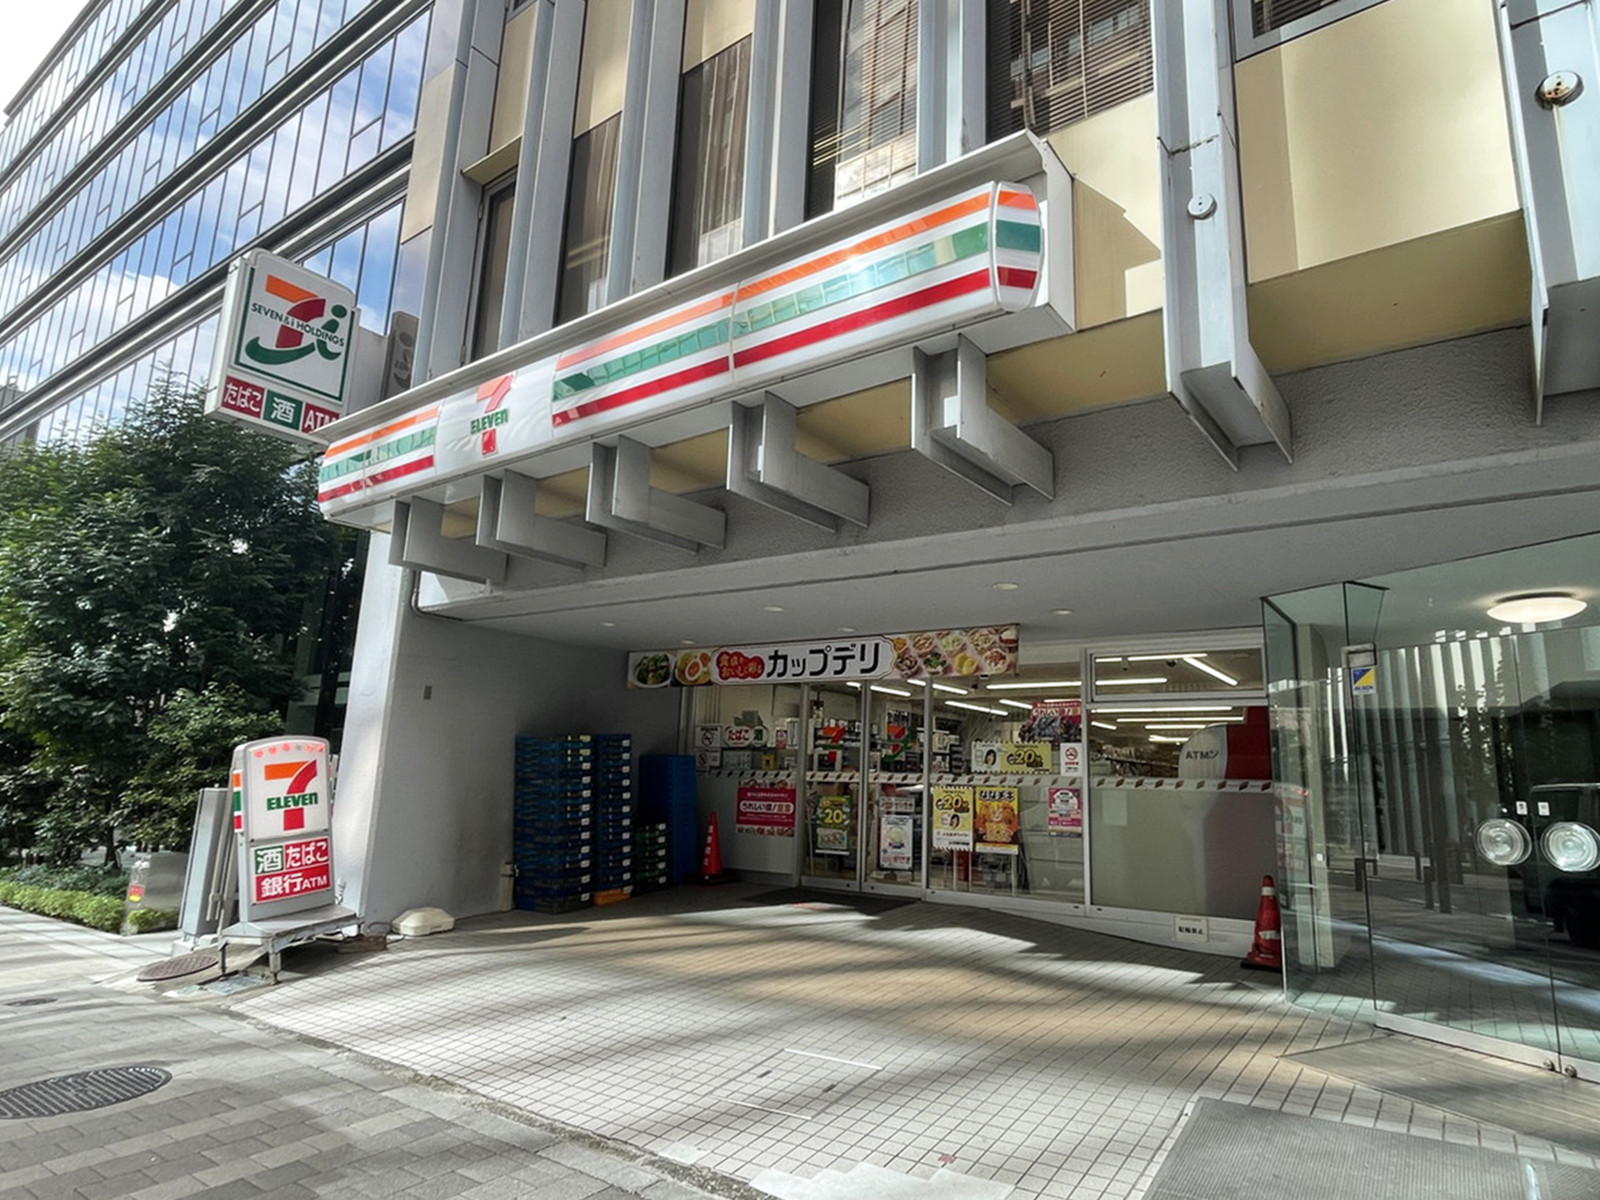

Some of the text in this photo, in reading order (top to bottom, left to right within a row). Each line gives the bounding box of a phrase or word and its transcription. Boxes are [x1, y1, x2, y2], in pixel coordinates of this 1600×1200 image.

[296, 321, 344, 347] HOLDINGS
[223, 382, 262, 412] たばこ
[271, 397, 296, 423] 酒
[767, 642, 880, 678] カップデリ
[257, 847, 283, 873] 酒
[286, 840, 329, 868] たばこ
